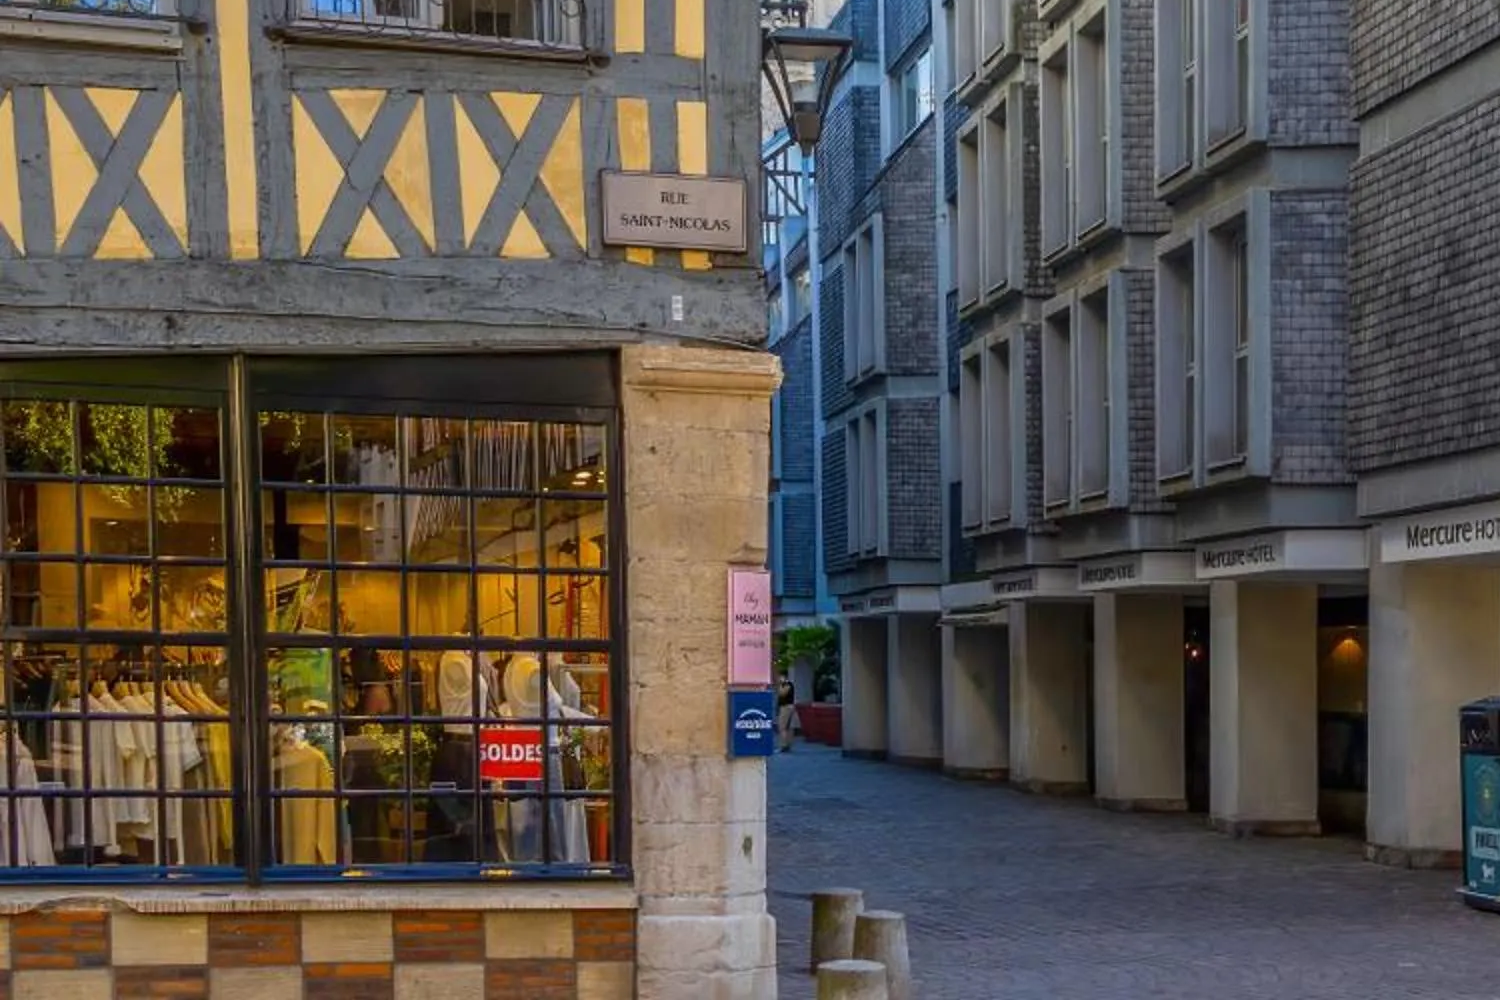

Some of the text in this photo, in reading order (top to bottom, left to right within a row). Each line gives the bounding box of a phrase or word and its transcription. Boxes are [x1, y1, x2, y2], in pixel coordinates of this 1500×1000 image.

[660, 191, 689, 204] RUE
[620, 213, 731, 231] SAINT-NICOLAS
[1406, 521, 1473, 549] Mercure
